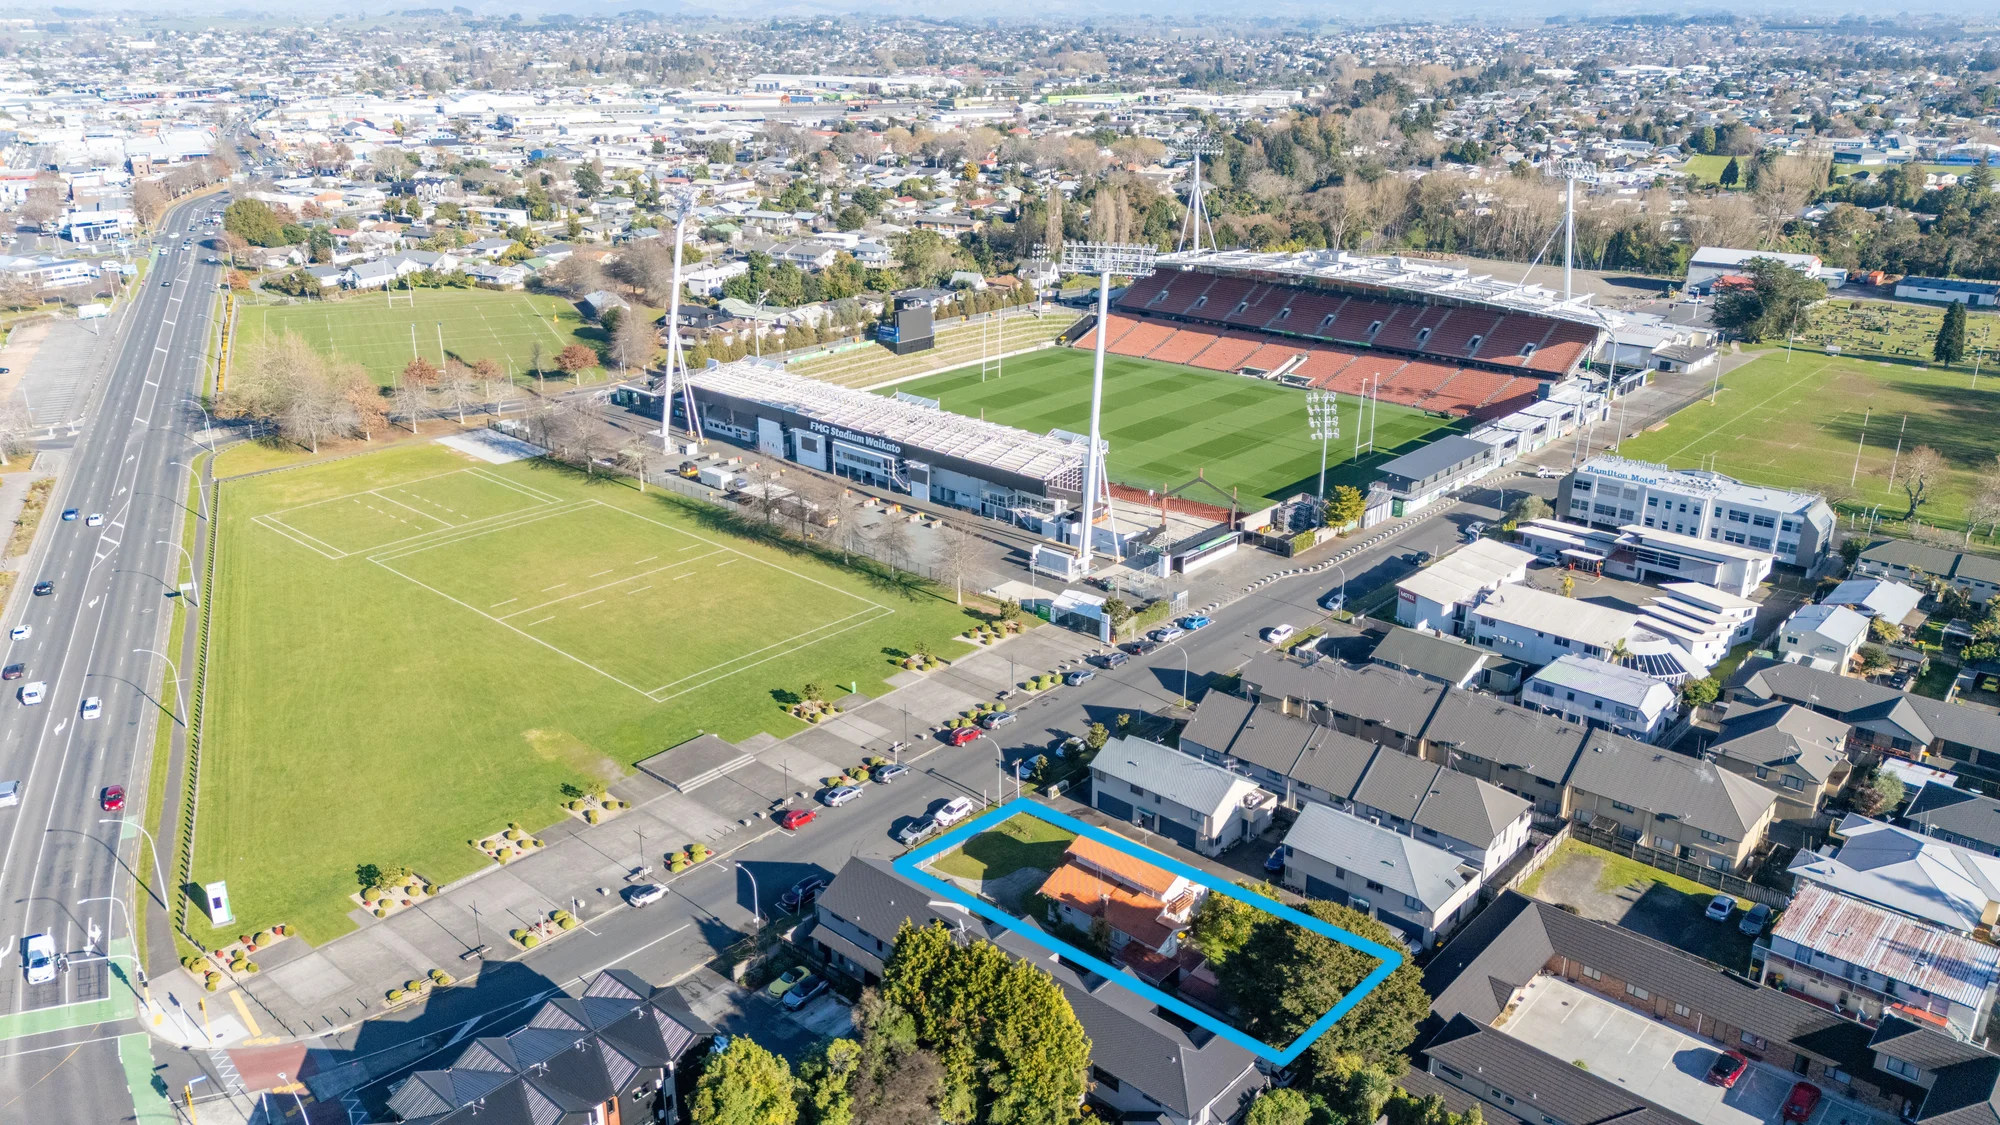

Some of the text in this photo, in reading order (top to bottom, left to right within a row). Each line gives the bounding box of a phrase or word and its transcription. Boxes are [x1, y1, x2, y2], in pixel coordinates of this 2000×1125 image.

[810, 421, 901, 454] FMG Stadium Waikato
[1587, 465, 1657, 485] Hamilton Motel
[1400, 591, 1415, 601] MOTEL
